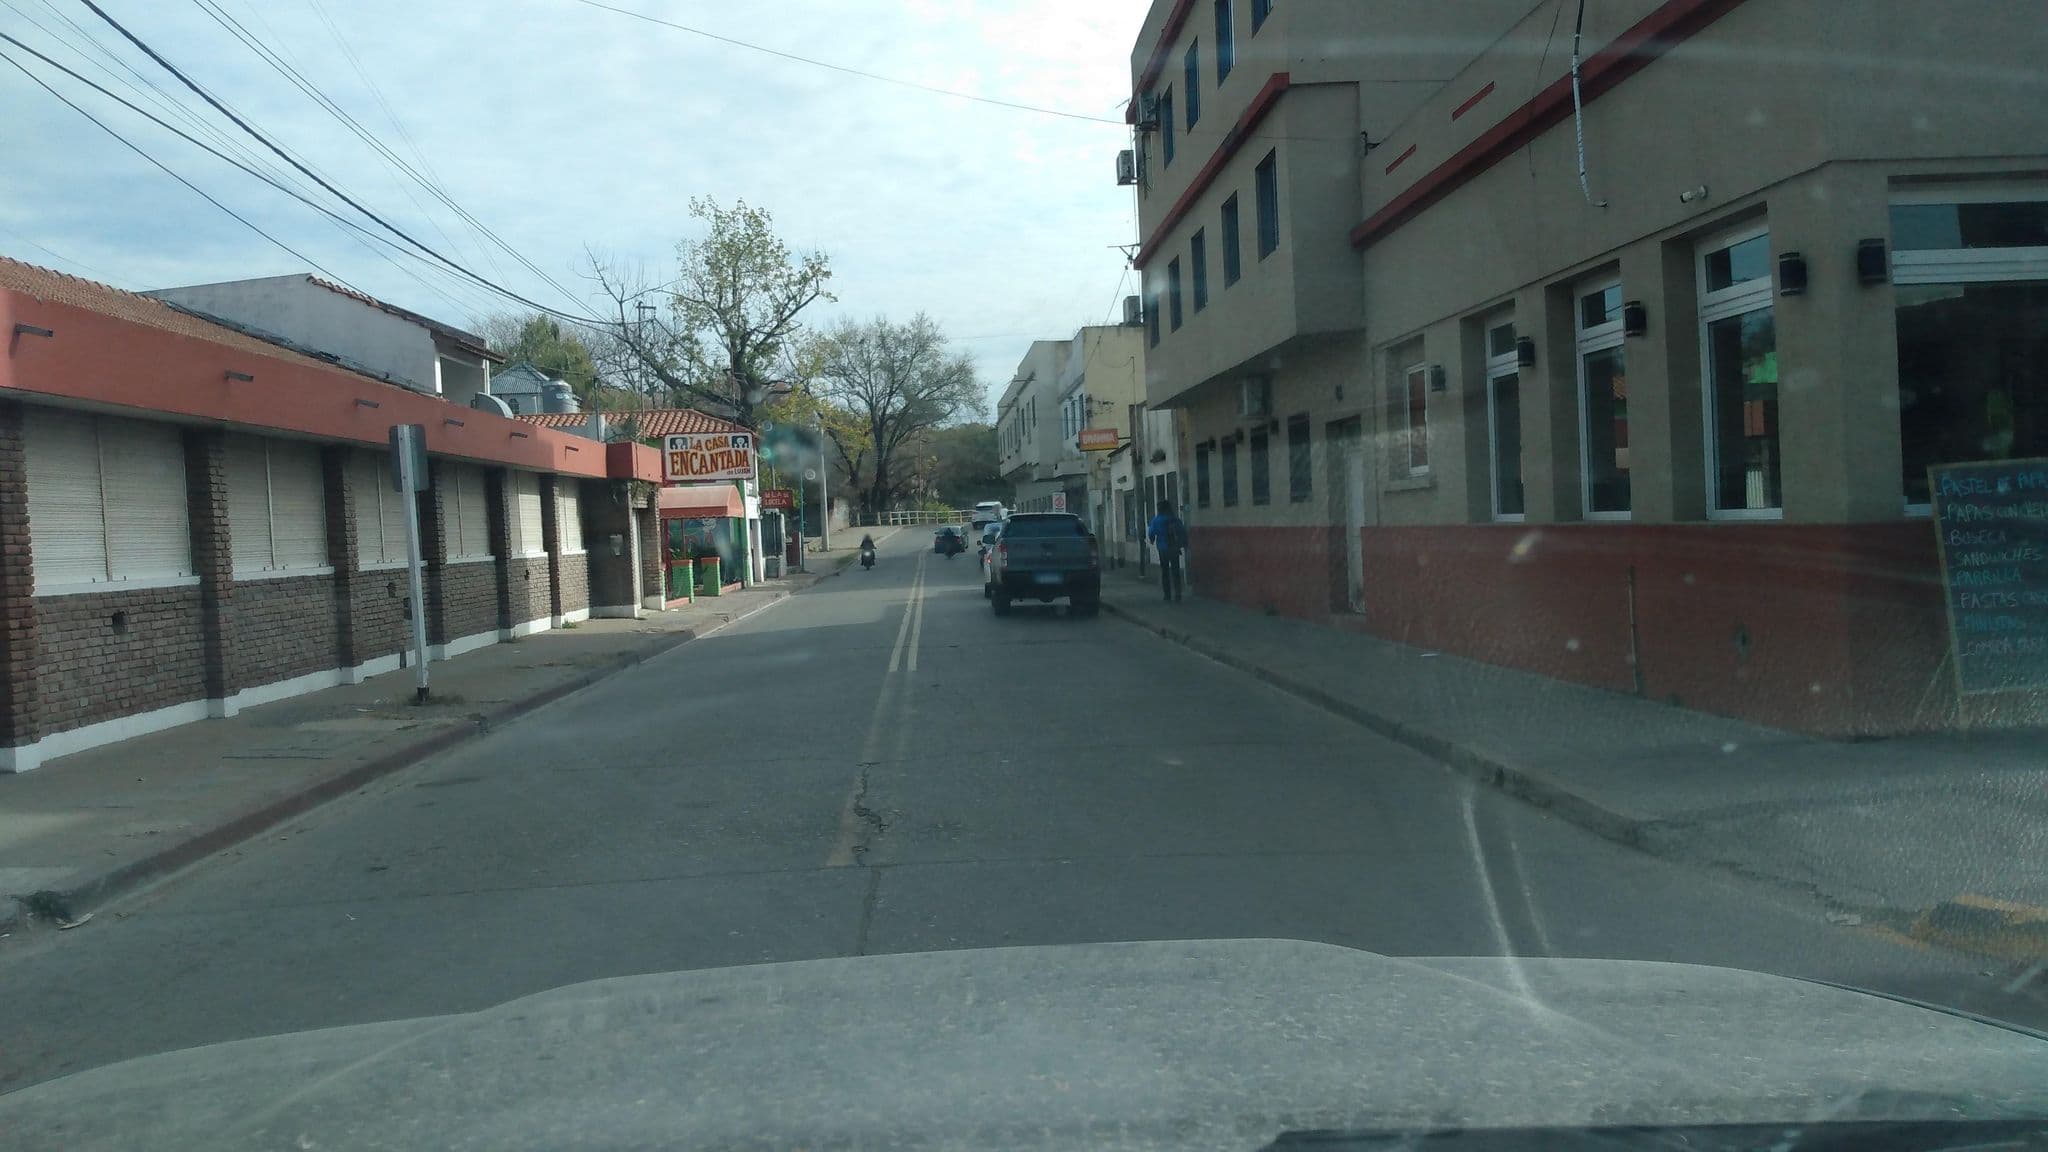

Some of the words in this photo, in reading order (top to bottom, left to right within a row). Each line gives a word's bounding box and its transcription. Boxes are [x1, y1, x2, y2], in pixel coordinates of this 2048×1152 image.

[689, 436, 703, 451] LA
[705, 436, 730, 451] CASA
[669, 450, 750, 476] ENCANTADA
[1941, 474, 1992, 498] PASTEL
[1947, 503, 1994, 523] PAPAS
[1960, 591, 2018, 609] PASTAS
